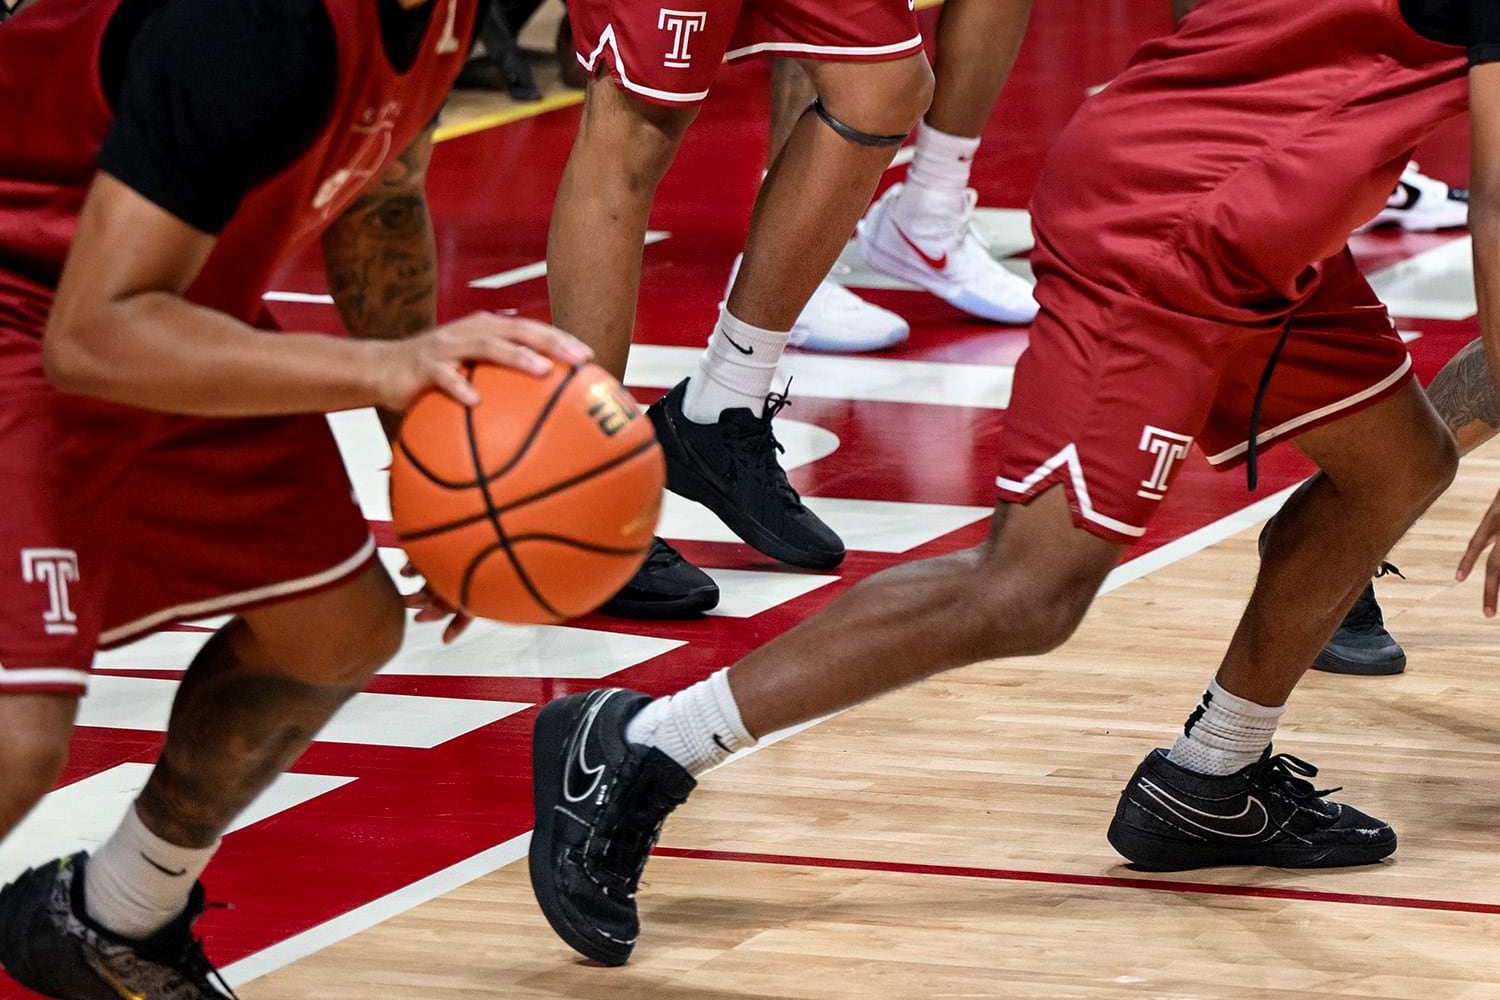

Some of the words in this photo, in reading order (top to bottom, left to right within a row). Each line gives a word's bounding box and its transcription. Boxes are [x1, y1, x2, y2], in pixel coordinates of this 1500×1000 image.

[658, 8, 707, 68] T
[1136, 425, 1194, 501] T
[21, 548, 80, 634] T
